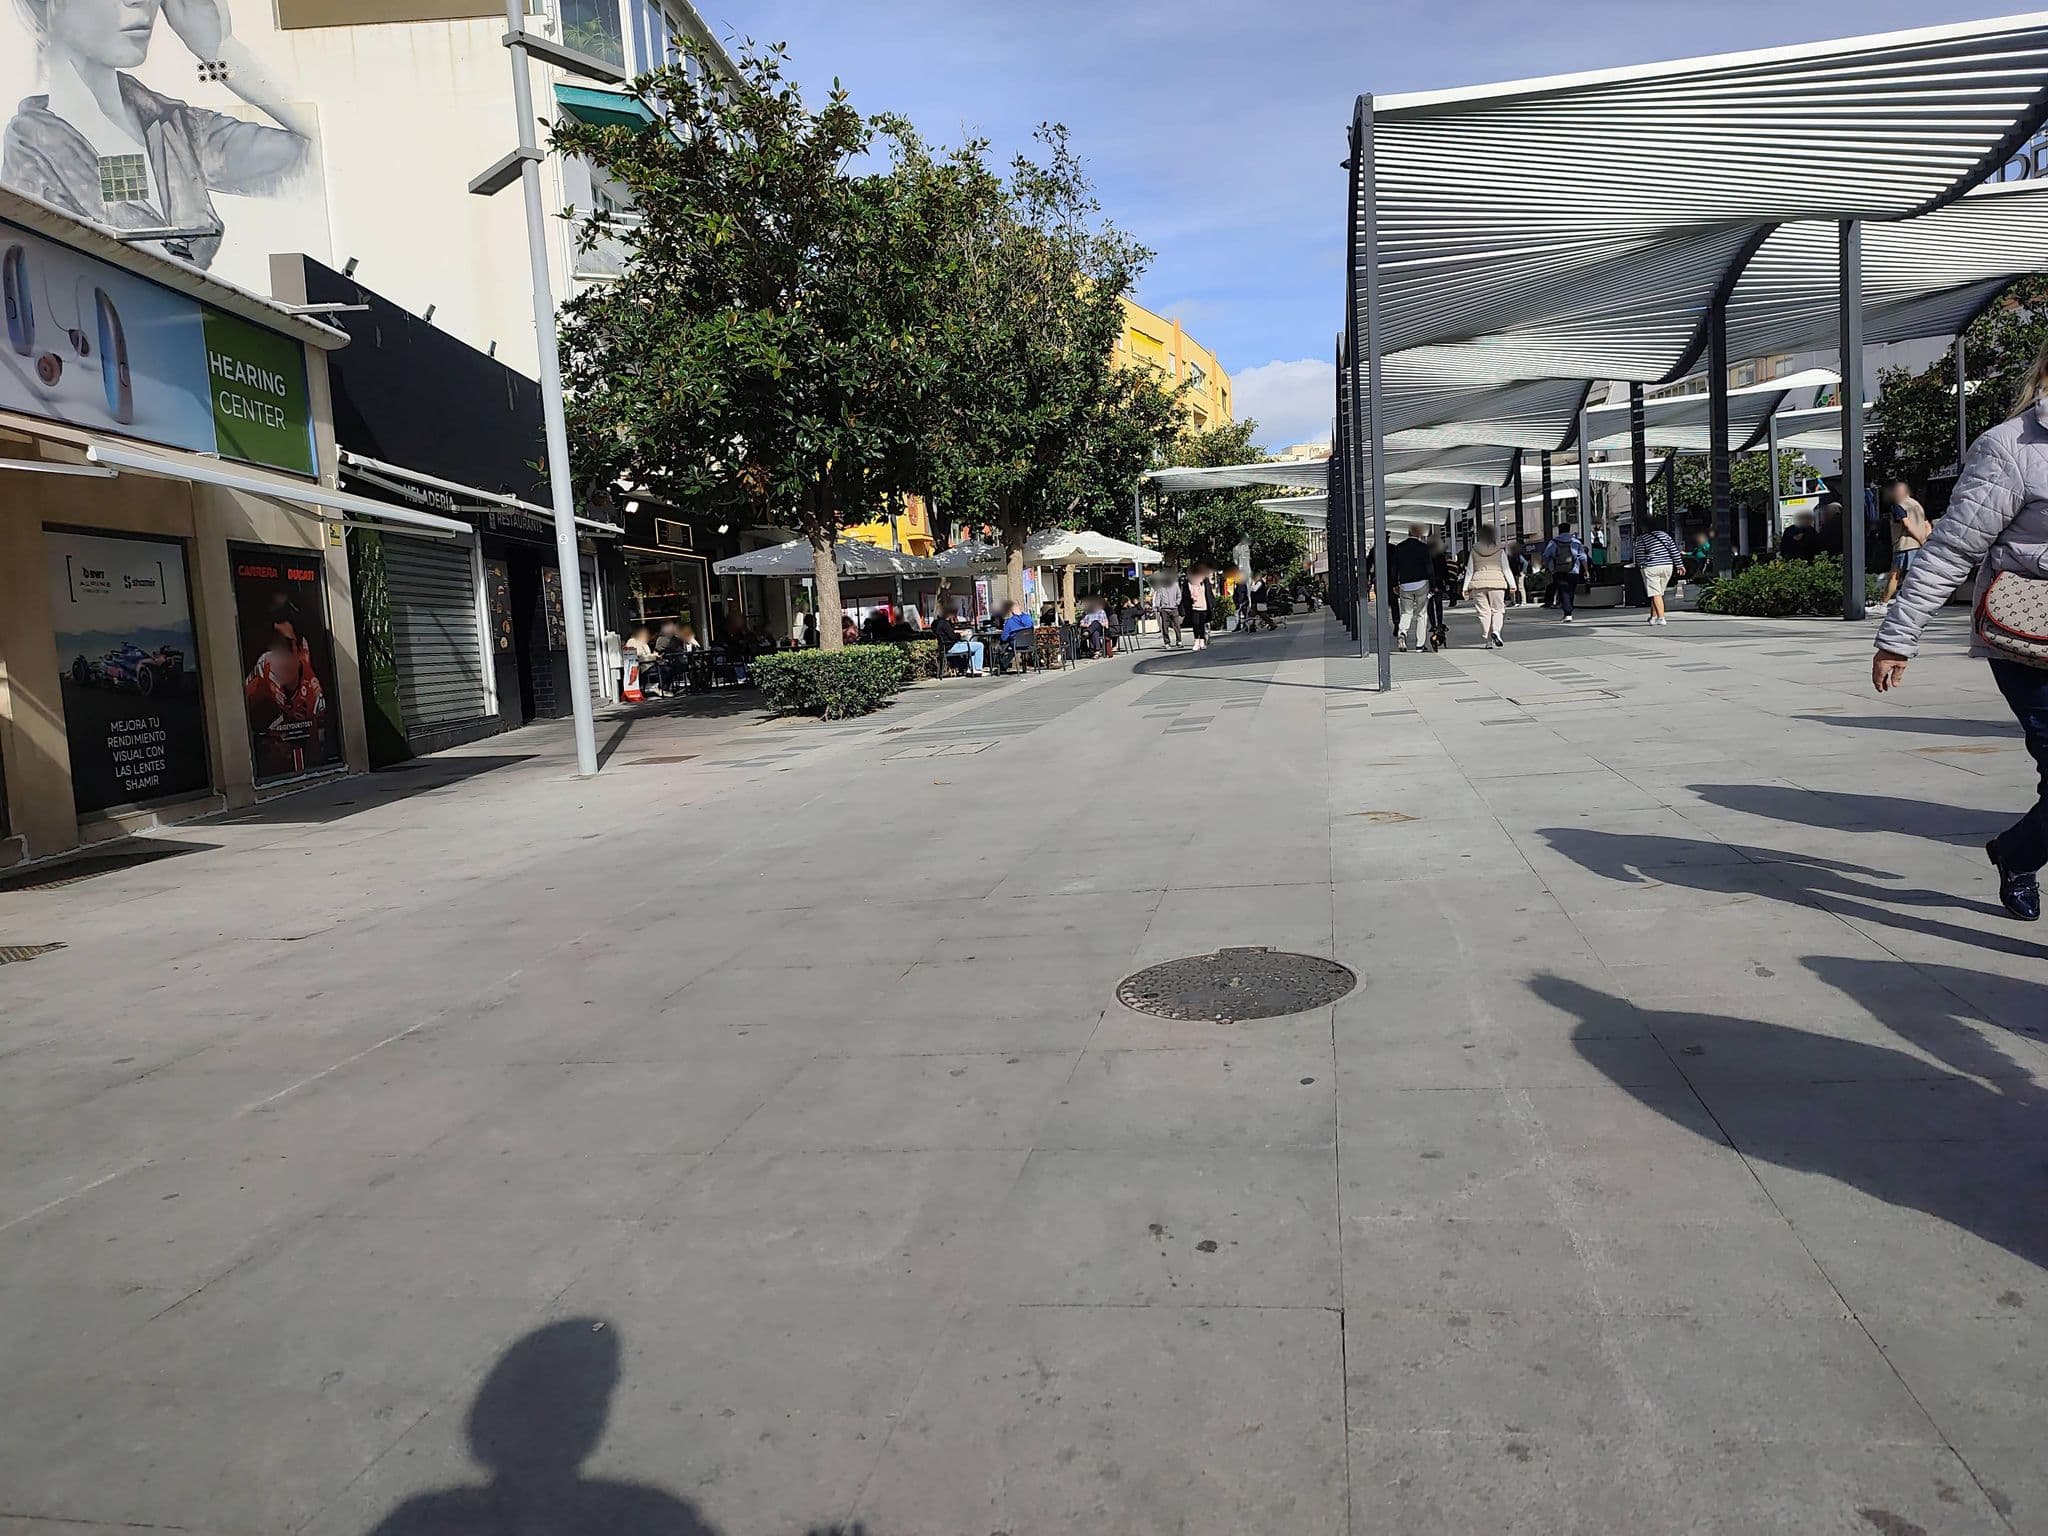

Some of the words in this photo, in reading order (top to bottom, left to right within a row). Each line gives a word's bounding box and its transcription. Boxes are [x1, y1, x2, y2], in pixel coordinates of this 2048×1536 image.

[210, 352, 286, 397] HEARING
[220, 391, 286, 430] CENTER
[497, 511, 544, 533] RESTAURANTE
[238, 564, 279, 578] CARRERA
[287, 568, 315, 581] DUCATI
[110, 718, 147, 732] MEJORA
[148, 716, 160, 728] TU
[107, 730, 166, 748] RENDIMIENTO
[112, 748, 145, 762] VISUAL
[145, 745, 165, 758] CON
[115, 764, 132, 778] LAS
[133, 759, 166, 775] LENTES
[125, 775, 160, 791] SHAMIR
